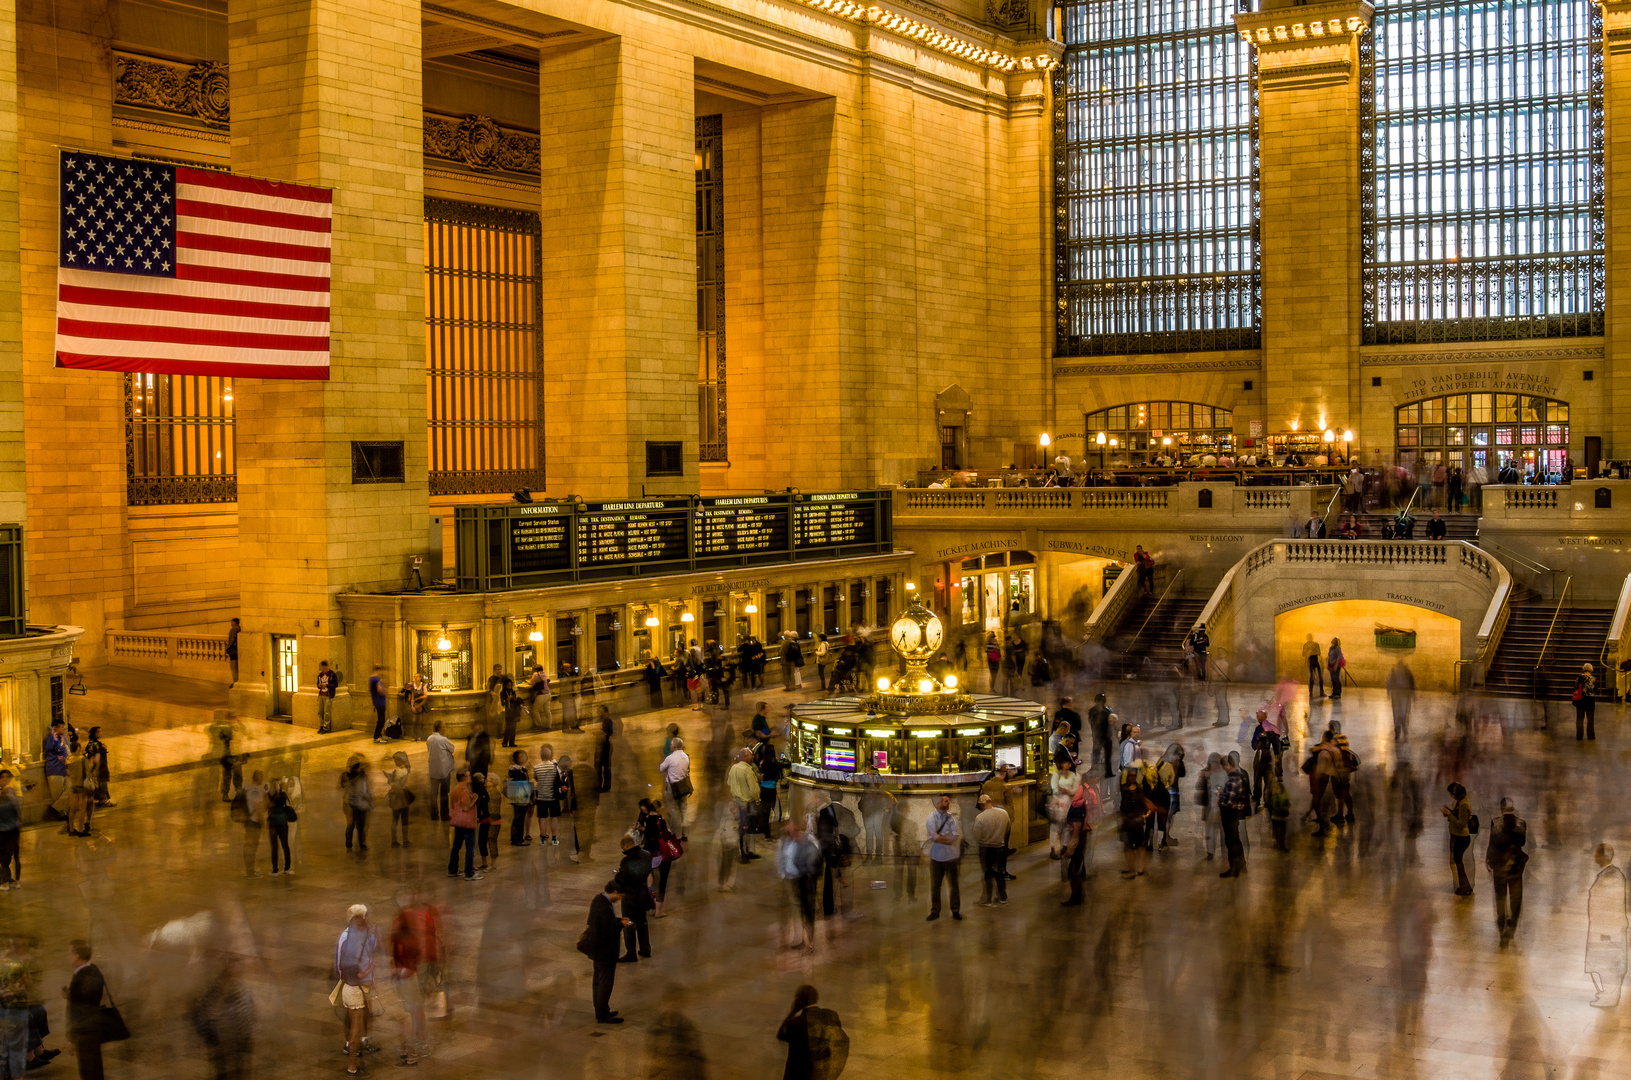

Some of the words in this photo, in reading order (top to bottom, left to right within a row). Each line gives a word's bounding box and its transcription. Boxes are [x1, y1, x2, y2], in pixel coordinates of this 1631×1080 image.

[1412, 379, 1426, 388] TO
[1432, 372, 1500, 383] VANDERBILT
[1506, 372, 1550, 384] AVENUE
[1404, 388, 1426, 399] THE
[1431, 381, 1487, 393] CAMPBELL
[1493, 381, 1558, 396] APARTMENT
[521, 506, 558, 514] INFORMATION
[624, 502, 635, 510] LINE
[937, 544, 968, 557] TICKET
[971, 540, 1017, 550] MACHINES
[1048, 540, 1084, 550] SUBWAY
[1091, 545, 1115, 556] 42ND
[1117, 550, 1129, 559] ST
[691, 585, 704, 594] MTA
[706, 580, 747, 592] METRO-NORTH
[748, 578, 769, 587] TICKETS
[1278, 598, 1304, 610] DINING
[1305, 592, 1345, 602] CONCOURSE
[1386, 592, 1412, 602] TRACKS
